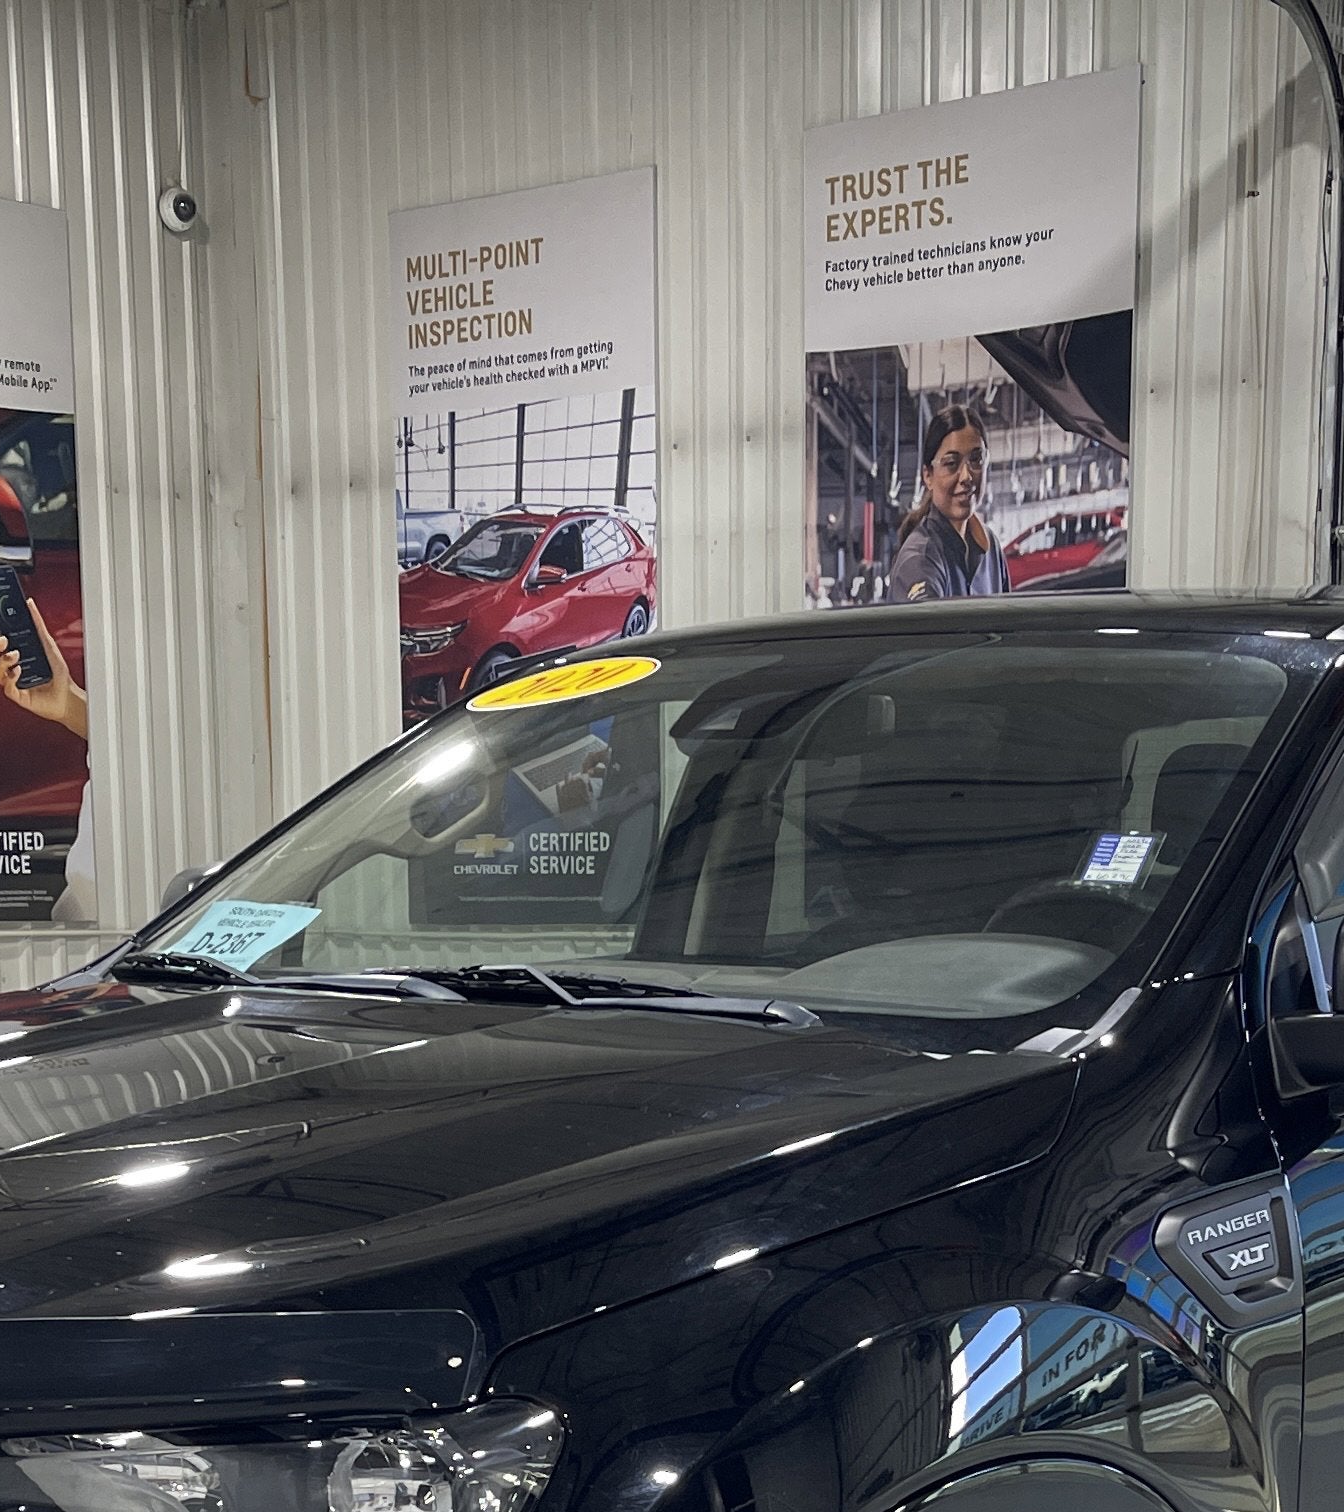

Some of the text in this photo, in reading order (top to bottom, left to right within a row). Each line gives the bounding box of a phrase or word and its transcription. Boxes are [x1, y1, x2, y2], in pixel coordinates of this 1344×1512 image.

[825, 153, 969, 205] TRUST THE
[826, 197, 953, 242] EXPERTS.
[407, 237, 543, 282] MULTI-POINT
[825, 228, 1054, 273] Factory trained technicians know your
[825, 254, 1025, 292] Chevy vehicle better than anyone.
[407, 280, 494, 316] VEHICLE
[408, 308, 532, 349] INSPECTION
[5, 359, 40, 372] remote
[408, 340, 613, 378] The peace of mind that comes from getting
[409, 381, 429, 397] your
[432, 375, 470, 391] vehicle's
[473, 372, 503, 386] health
[506, 367, 545, 382] checked
[548, 363, 569, 376] with
[572, 365, 578, 373] a
[529, 832, 610, 852] CERTIFIED
[454, 865, 518, 875] CHEVROLET
[529, 855, 595, 874] SERVICE
[1187, 1209, 1270, 1245] RANGER
[1227, 1243, 1269, 1270] XLT
